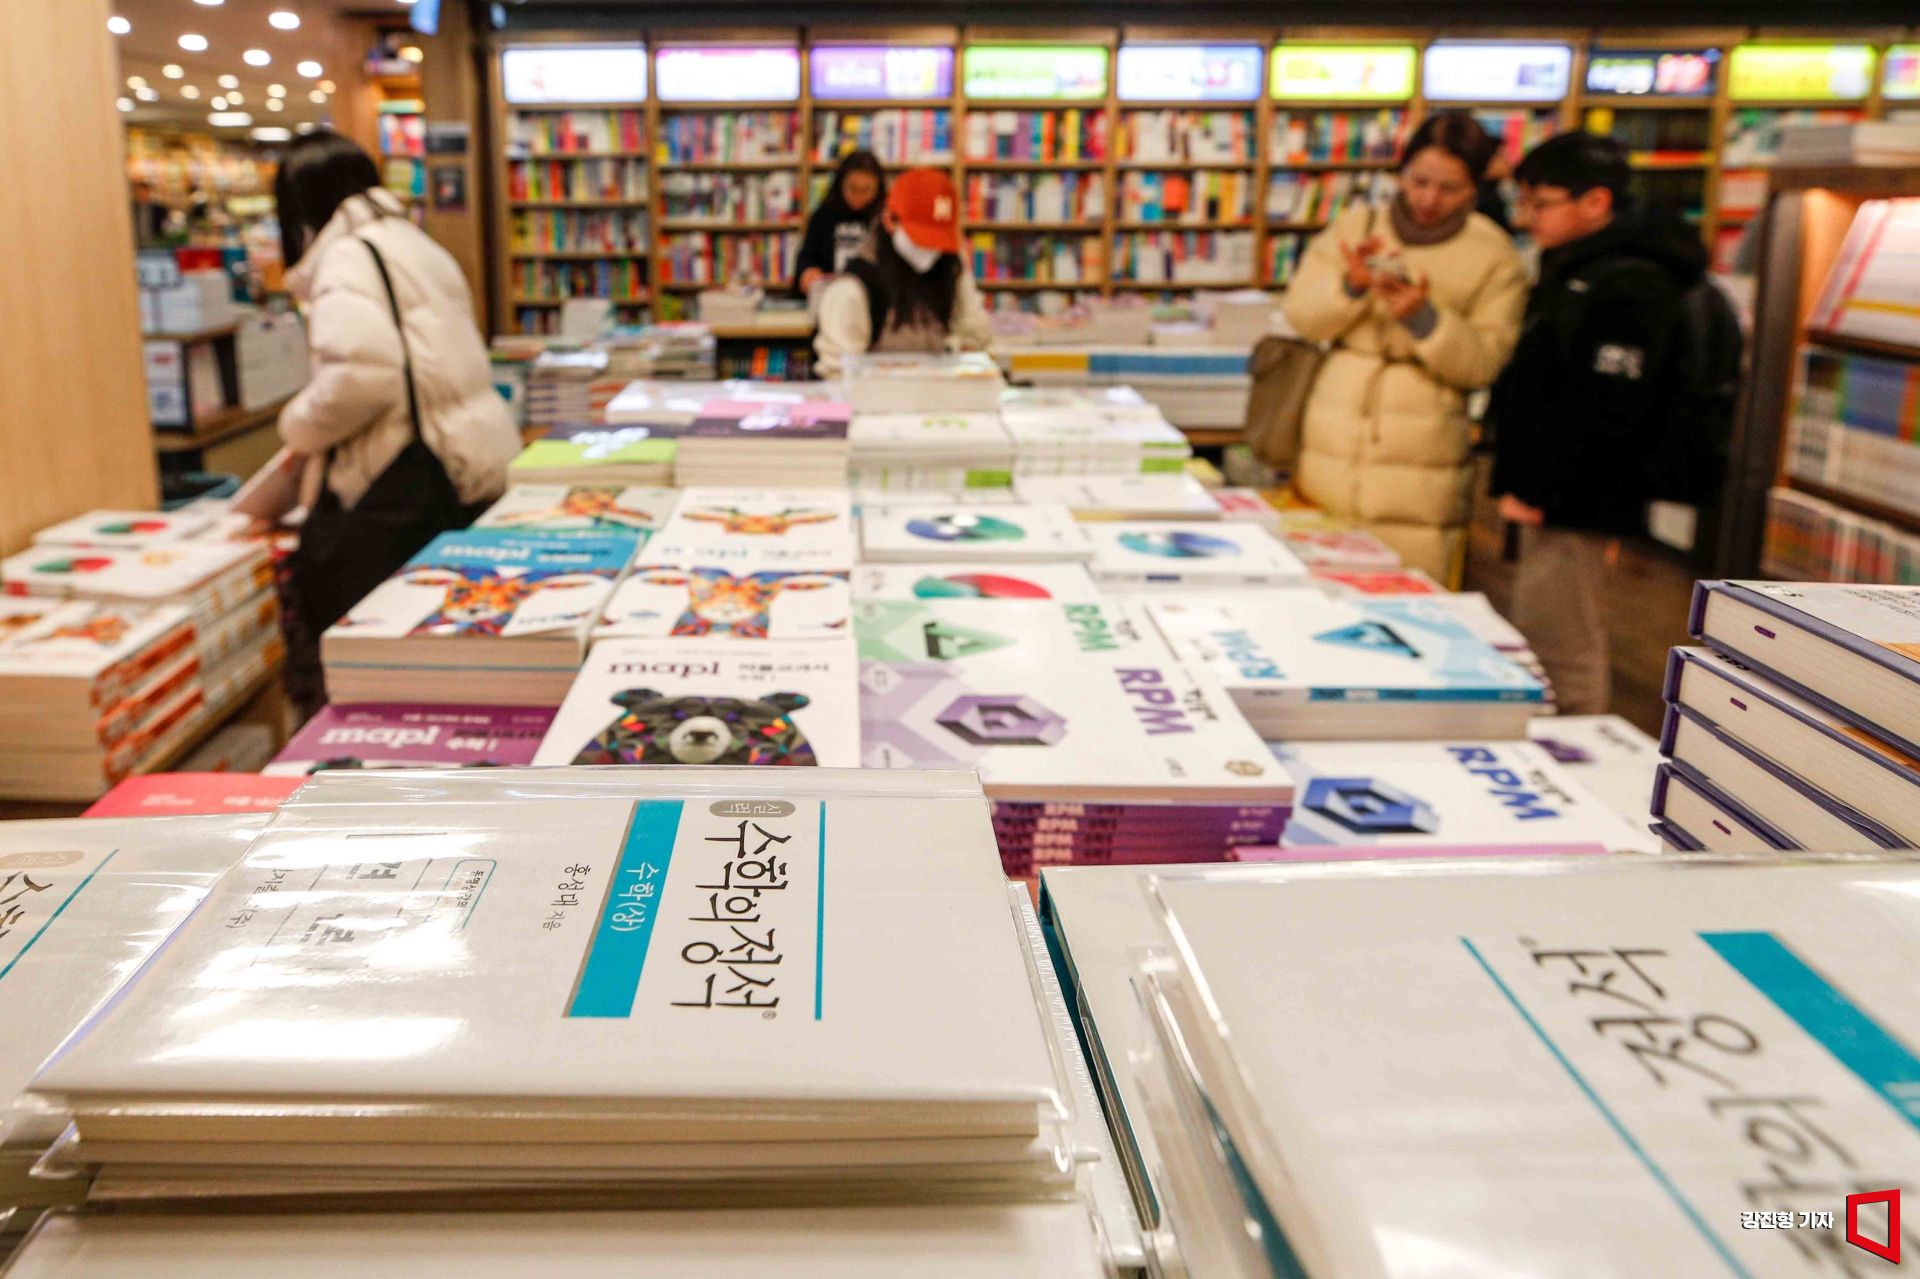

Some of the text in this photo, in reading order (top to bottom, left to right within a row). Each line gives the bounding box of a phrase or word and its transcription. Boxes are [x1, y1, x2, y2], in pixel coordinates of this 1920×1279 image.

[1064, 603, 1121, 652] RPM
[608, 660, 720, 678] mapl
[1113, 667, 1195, 737] RPM
[320, 724, 441, 749] mapl
[722, 803, 782, 815] 실력
[1446, 746, 1562, 821] RPM
[543, 864, 592, 932] 홍성대 지음
[609, 861, 661, 932] 수학(상)
